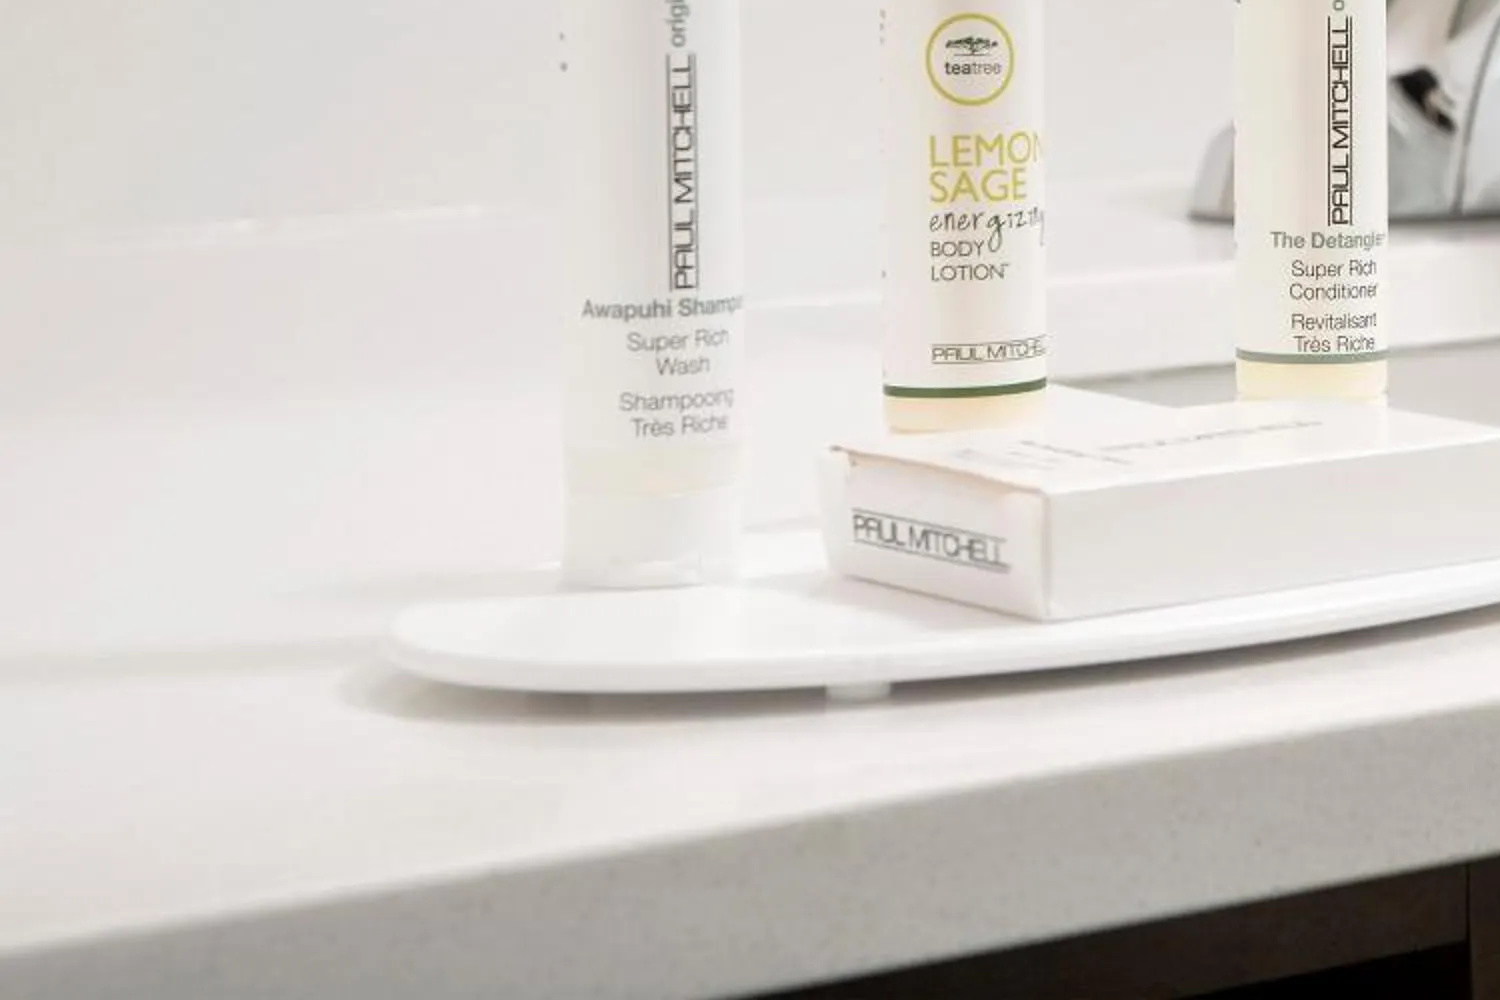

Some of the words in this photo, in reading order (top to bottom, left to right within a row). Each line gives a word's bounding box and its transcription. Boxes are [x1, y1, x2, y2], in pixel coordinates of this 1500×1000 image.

[1331, 15, 1349, 149] MITCHELL
[670, 54, 694, 205] MITCHELL
[929, 167, 1028, 203] SAGE
[1331, 153, 1349, 225] PAUL
[673, 208, 696, 290] PAUL
[930, 239, 985, 258] BODY
[1270, 231, 1306, 249] The
[1310, 230, 1386, 252] Detangle
[1291, 259, 1345, 281] Super
[1348, 259, 1378, 277] Rich
[581, 299, 672, 323] Awapuhi
[626, 331, 689, 354] Super
[694, 328, 730, 348] Rich
[1293, 335, 1331, 353] Très
[1337, 334, 1375, 352] Riche
[655, 355, 711, 376] Wash
[932, 346, 982, 361] PAUL
[631, 416, 675, 438] Très
[680, 414, 729, 435] Riche
[853, 513, 907, 547] PAUL
[908, 525, 1010, 569] MITCHELL
